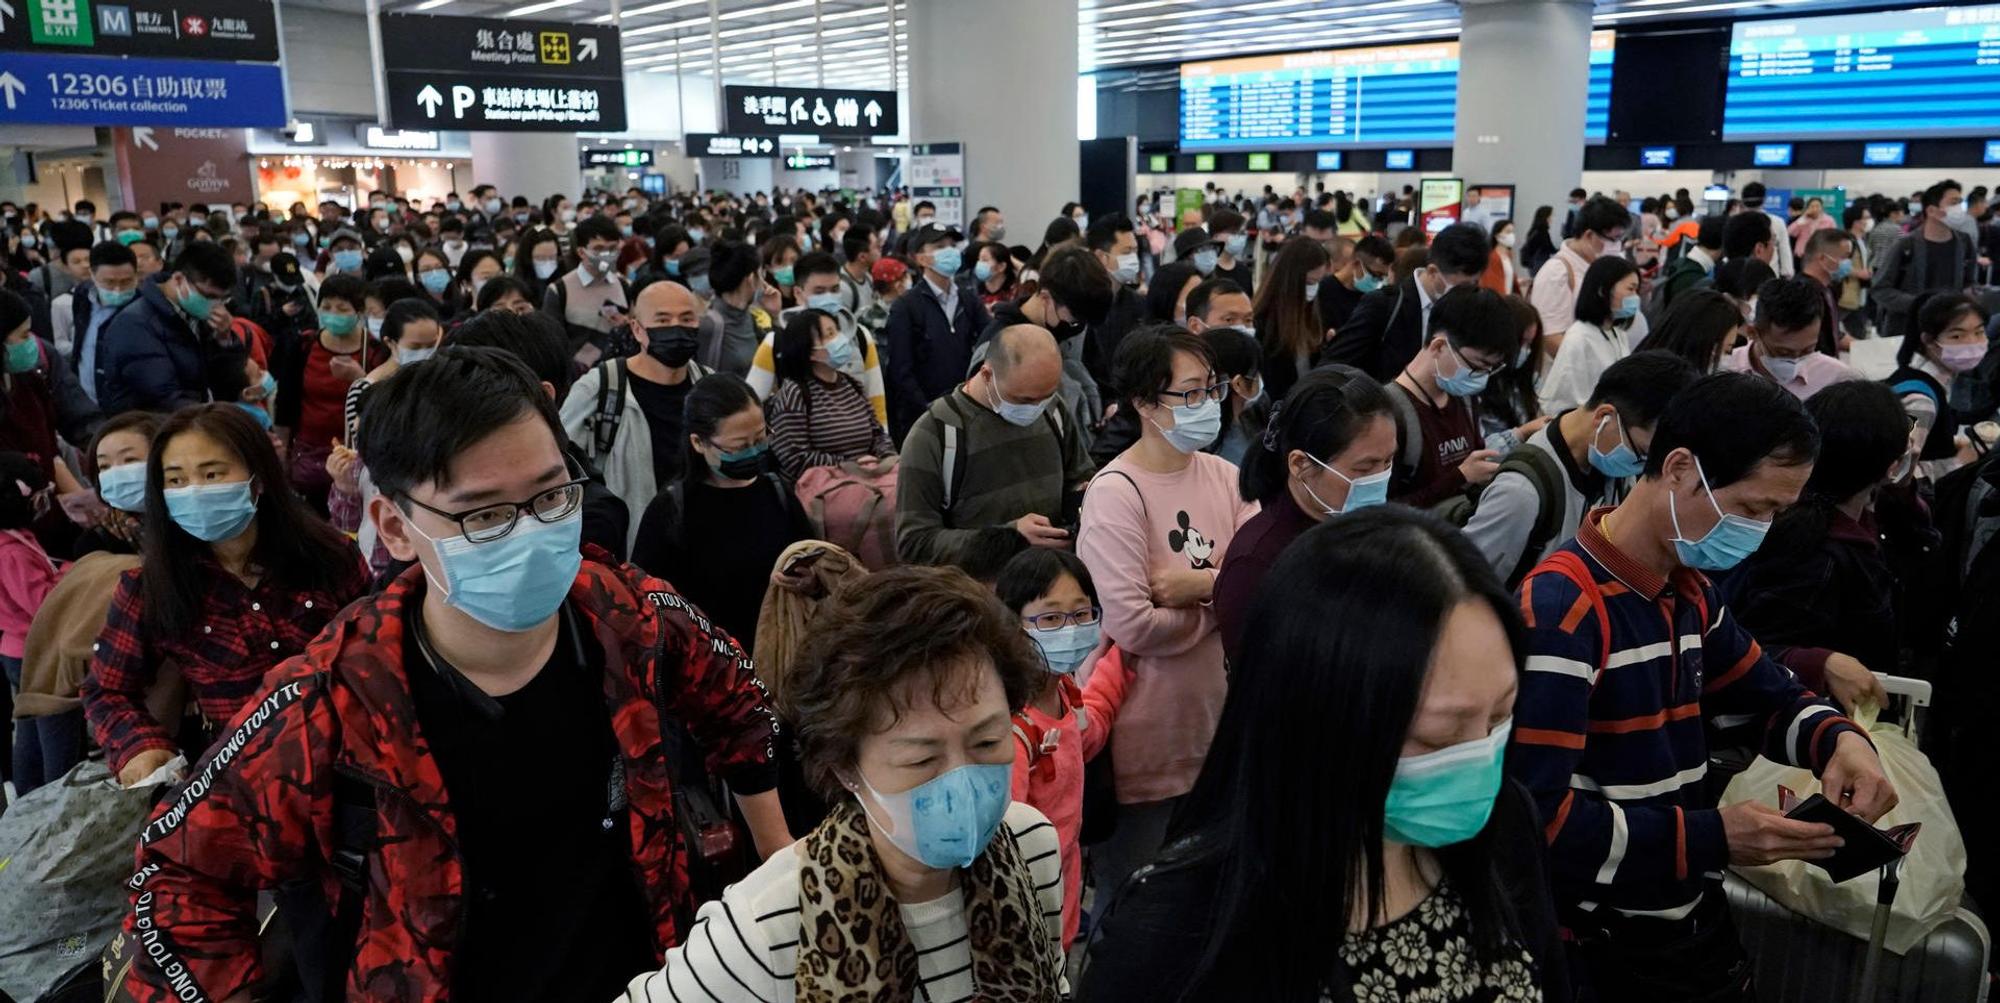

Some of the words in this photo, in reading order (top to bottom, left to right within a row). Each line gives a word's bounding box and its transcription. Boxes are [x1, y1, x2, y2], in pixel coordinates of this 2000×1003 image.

[44, 24, 77, 37] EXIT
[476, 29, 534, 50] 集合處
[471, 50, 511, 64] Meeting
[512, 53, 536, 63] Point
[48, 73, 127, 96] 12306
[132, 75, 227, 99] 自助取票
[51, 98, 89, 110] 12306
[91, 99, 128, 111] Ticket
[130, 100, 188, 113] collection
[452, 85, 476, 118] P
[213, 729, 246, 770] TONG
[243, 692, 280, 736] TOUY
